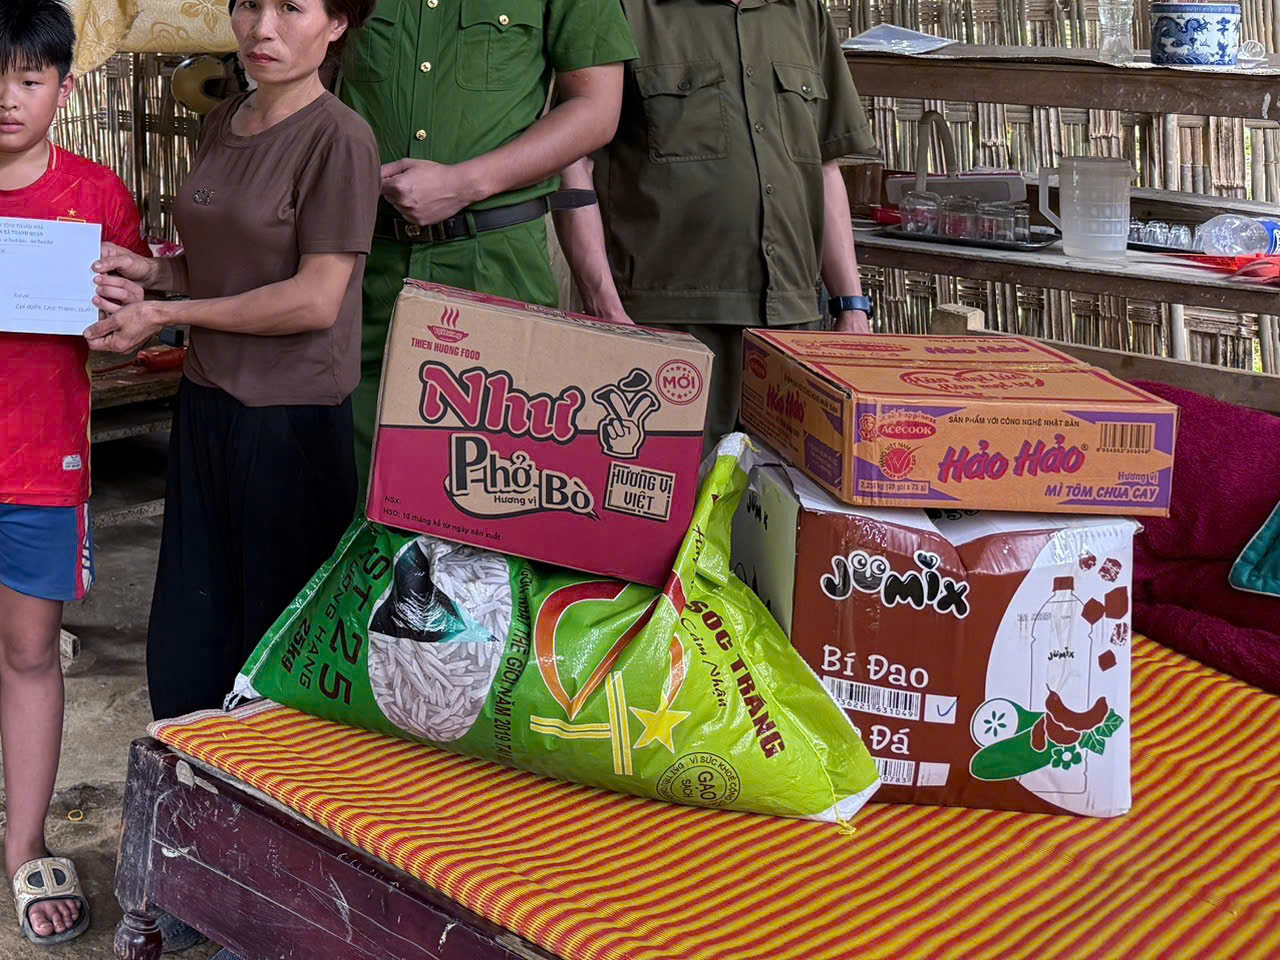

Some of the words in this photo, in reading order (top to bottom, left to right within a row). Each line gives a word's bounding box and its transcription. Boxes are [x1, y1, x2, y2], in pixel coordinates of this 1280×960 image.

[434, 342, 460, 356] HUONG
[460, 348, 480, 361] FOOD
[421, 362, 584, 444] Như
[1000, 417, 1020, 426] CÔNG
[937, 440, 1010, 484] Hảo
[1013, 433, 1086, 478] Hảo
[453, 434, 534, 492] Phở
[545, 472, 591, 510] Bò
[493, 495, 526, 506] Hương
[528, 495, 536, 507] vị
[623, 490, 656, 514] VIỆT
[1045, 484, 1063, 497] MÌ
[1066, 484, 1093, 498] TÔM
[1096, 486, 1130, 499] CHUA
[1132, 487, 1158, 500] CAY
[821, 644, 857, 677] Bí
[866, 654, 929, 689] Đao
[685, 600, 734, 652] SÓC
[730, 653, 786, 760] TRĂNG
[496, 686, 516, 718] NĂM
[876, 705, 914, 718] 631049
[494, 718, 512, 742] 2019
[869, 724, 910, 755] Đá
[700, 754, 718, 766] SỨC
